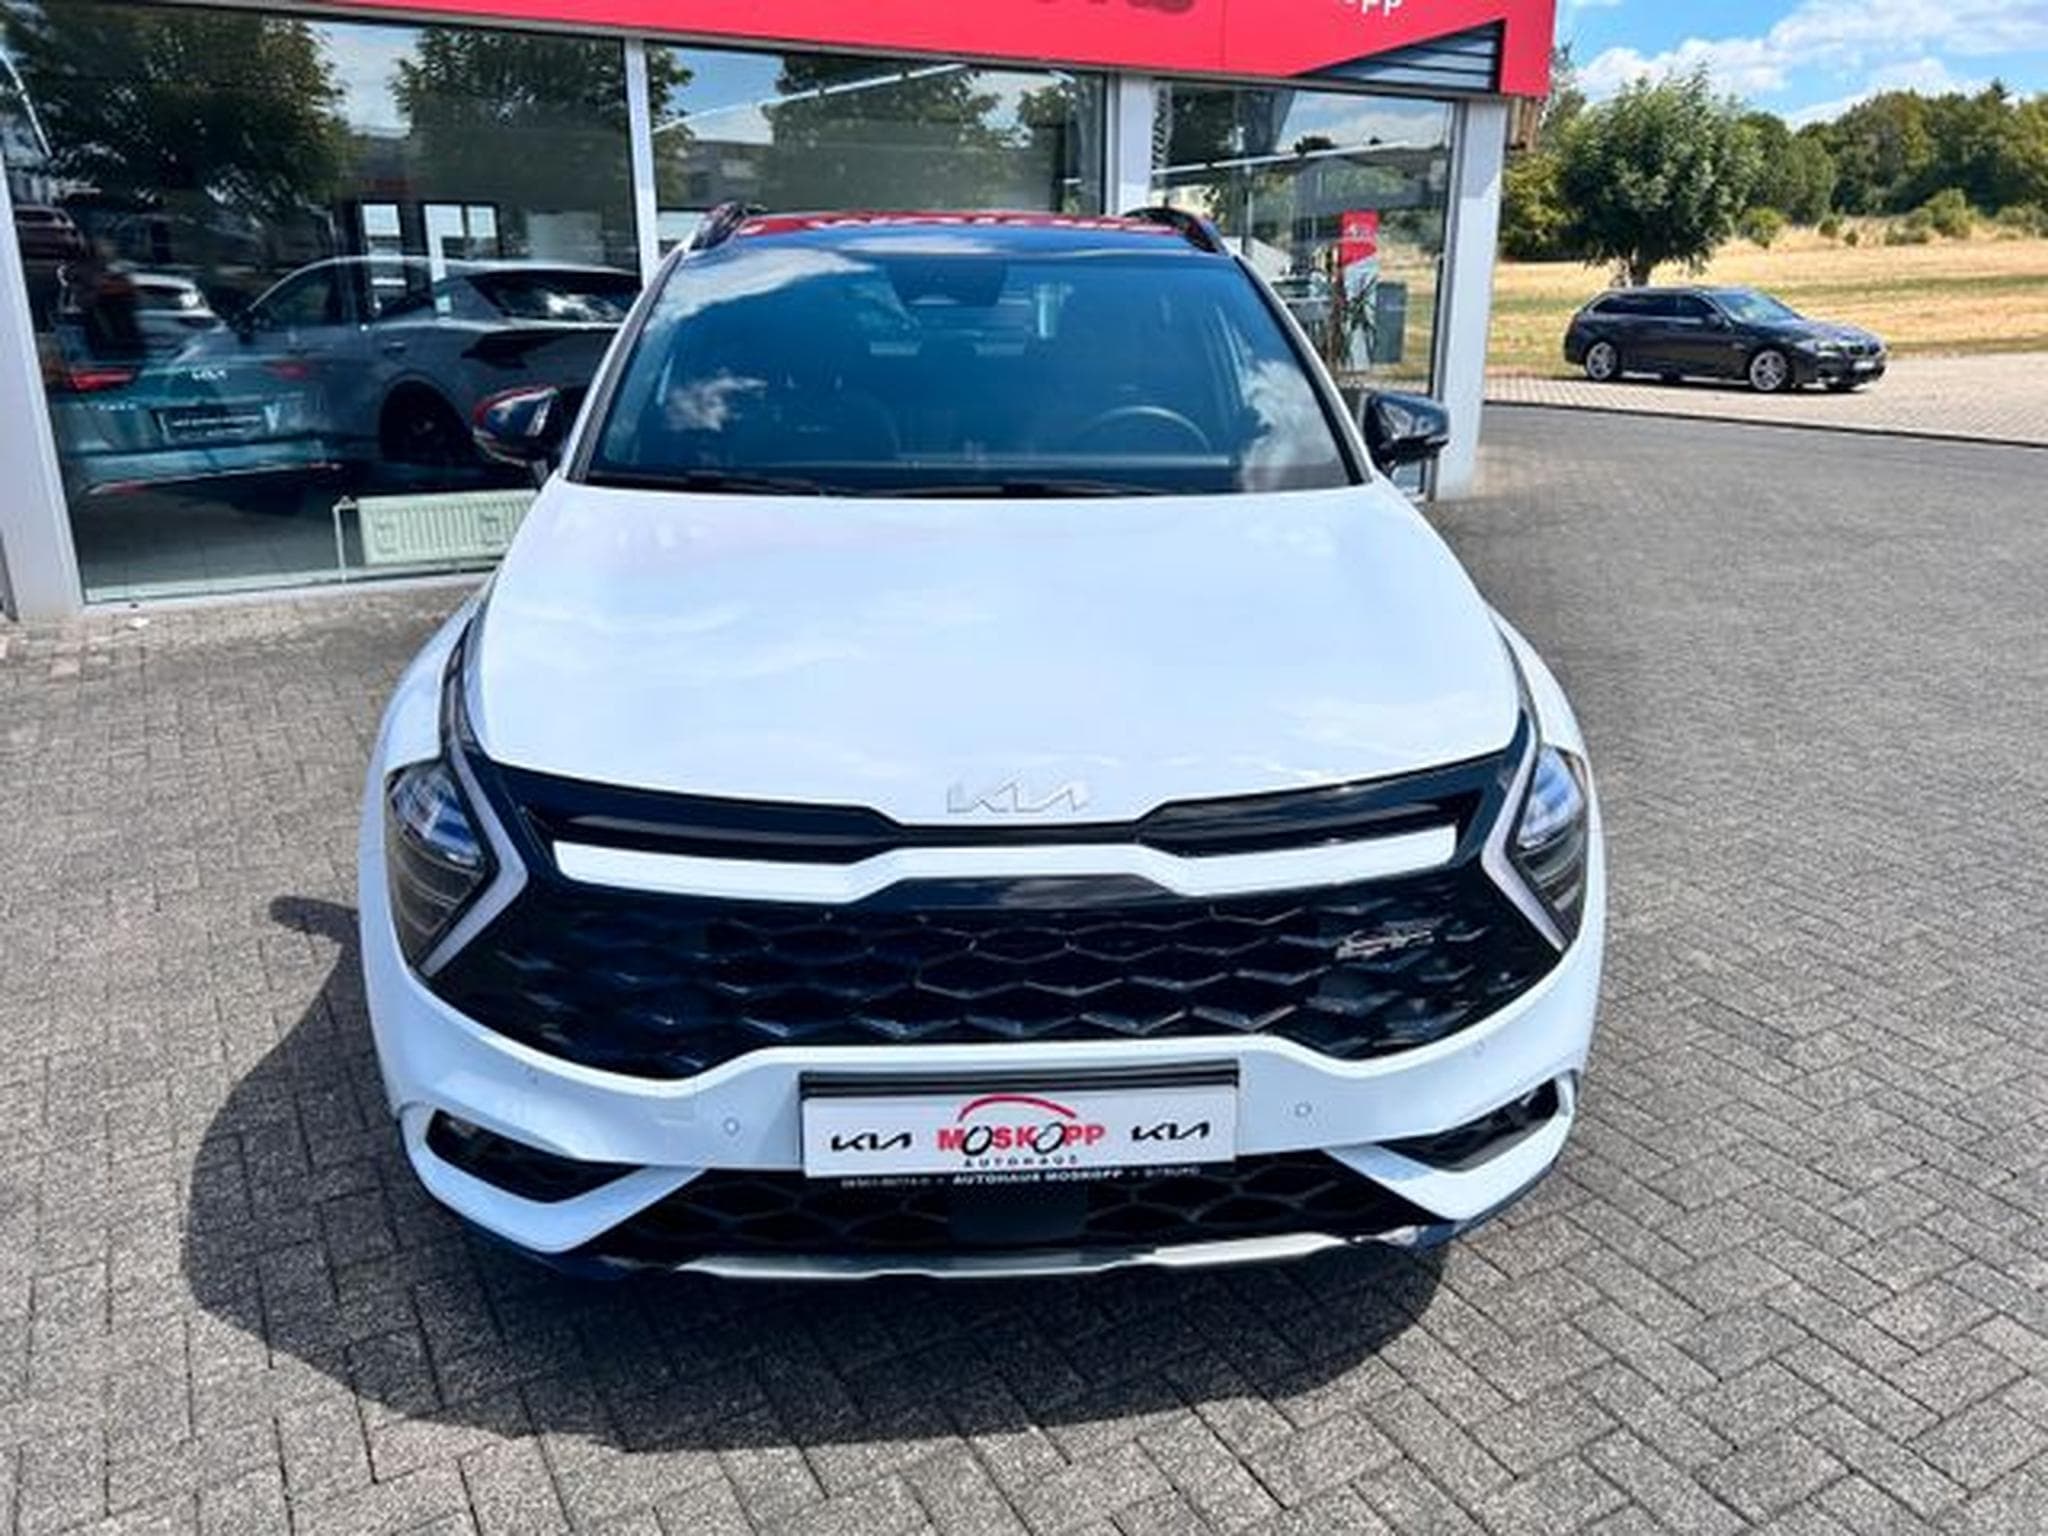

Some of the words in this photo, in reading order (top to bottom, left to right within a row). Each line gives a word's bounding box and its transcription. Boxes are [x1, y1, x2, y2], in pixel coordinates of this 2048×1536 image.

[946, 779, 1088, 813] KIA
[937, 1121, 1105, 1156] MOSKOPP
[1132, 1121, 1210, 1141] KIA
[831, 1132, 912, 1151] KIA
[964, 1155, 1078, 1168] AUTOHAUS
[953, 1171, 1040, 1186] AUTOHAUS
[1045, 1168, 1124, 1182] MOSKOPP
